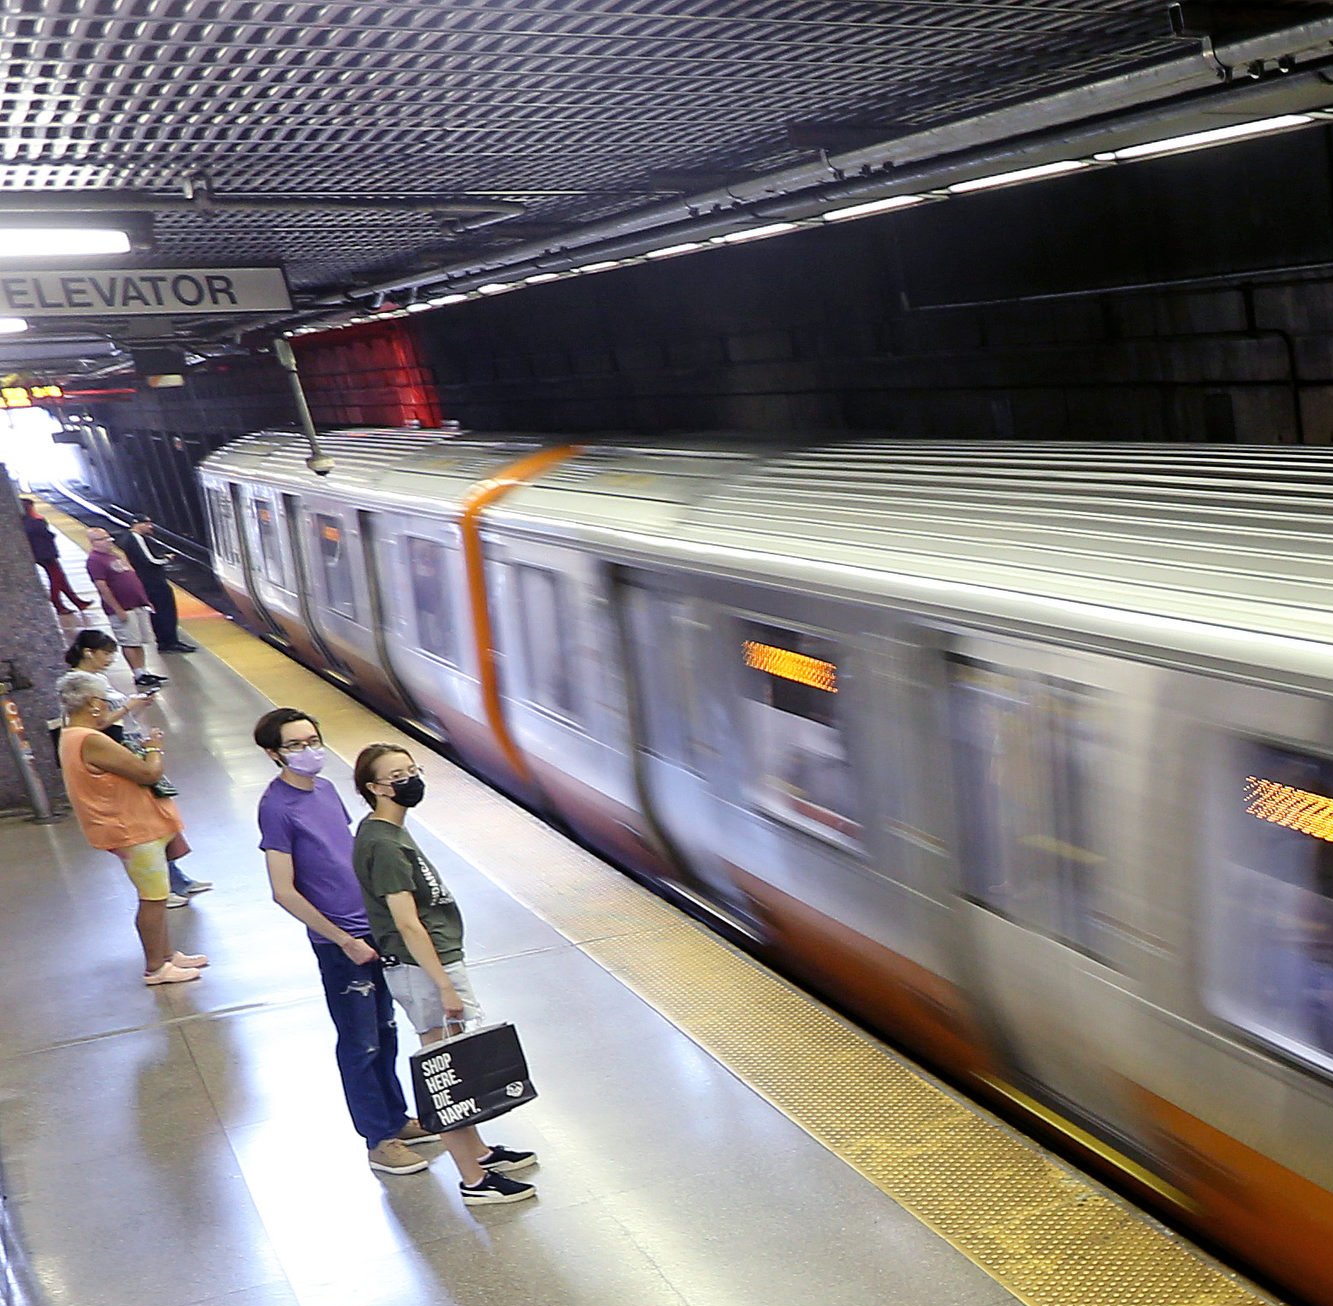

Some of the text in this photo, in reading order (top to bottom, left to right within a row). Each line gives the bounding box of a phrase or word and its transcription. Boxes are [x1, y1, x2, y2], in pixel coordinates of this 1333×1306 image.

[1, 275, 238, 309] ELEVATOR
[421, 1053, 452, 1077] SHOP
[425, 1069, 463, 1094] HERE.
[432, 1089, 455, 1110] DIE
[437, 1098, 482, 1126] HAPPY.
